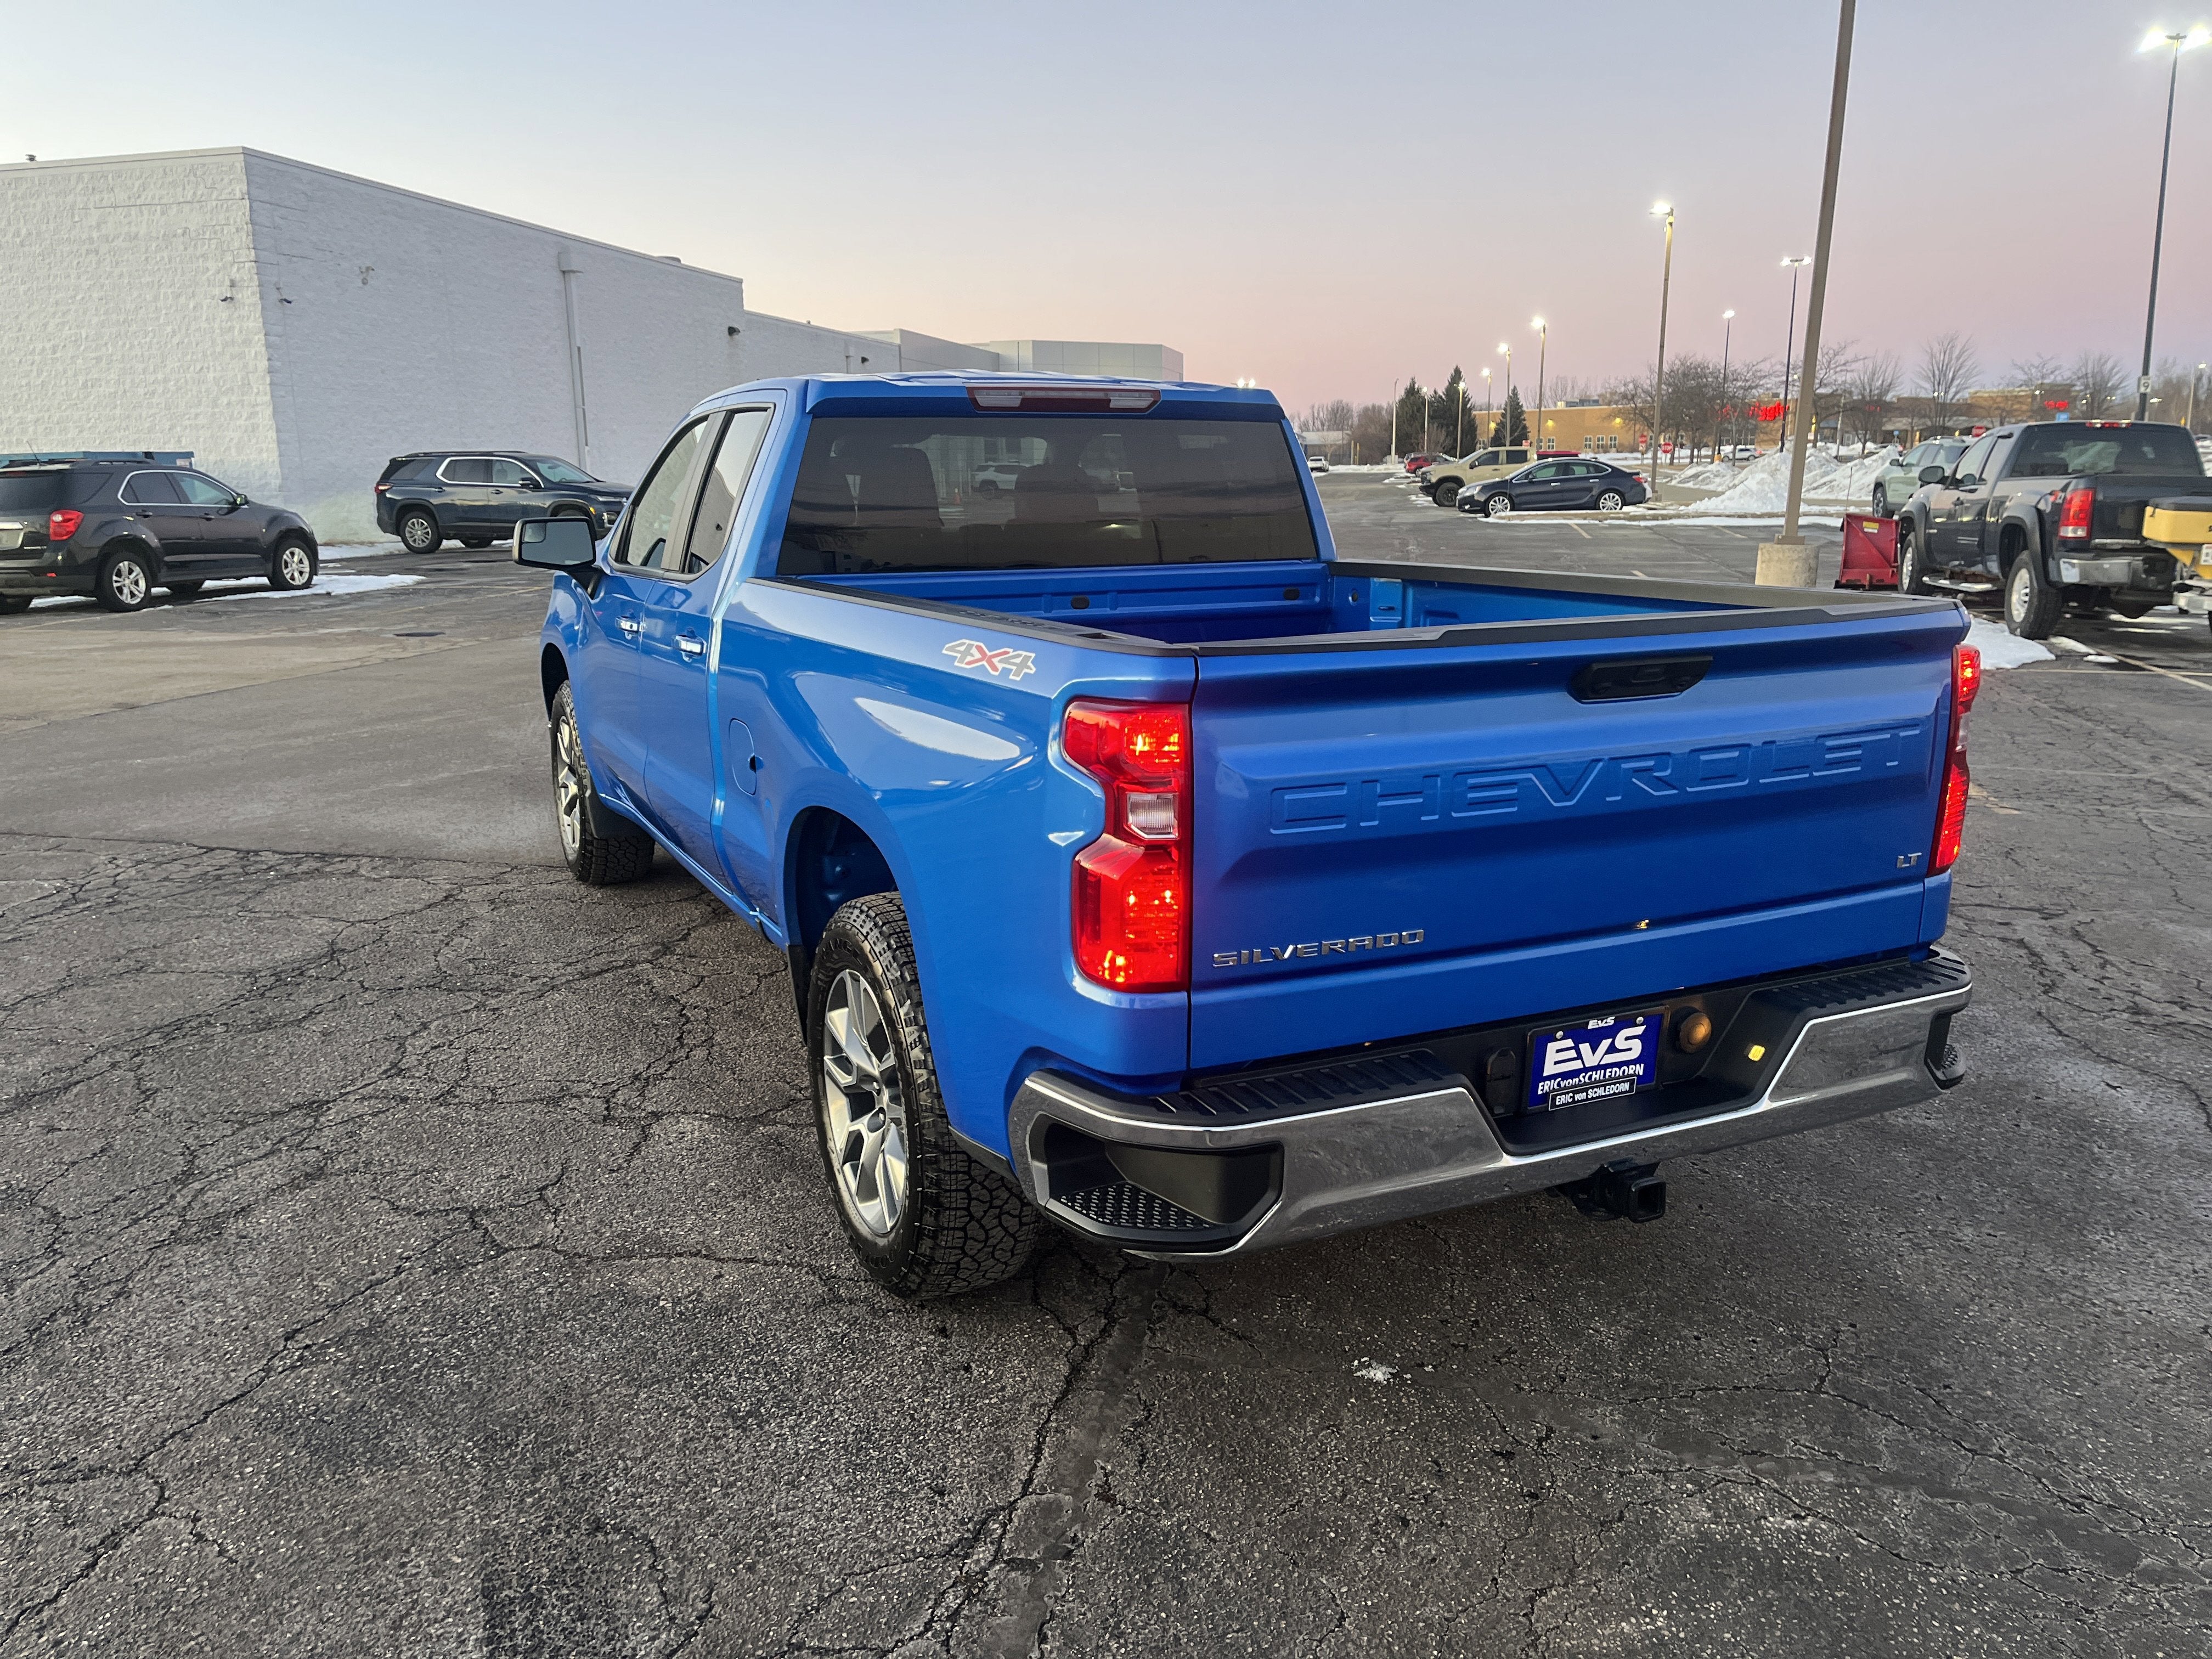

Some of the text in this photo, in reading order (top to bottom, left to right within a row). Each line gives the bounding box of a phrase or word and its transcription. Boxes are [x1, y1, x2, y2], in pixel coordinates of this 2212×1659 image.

[2143, 381, 2150, 391] 9
[1269, 722, 1921, 834] CHEVROLET
[1897, 852, 1922, 868] LT
[1212, 929, 1425, 968] SILVERADO
[1556, 1081, 1630, 1105] ERIC von SCHLEDORN
